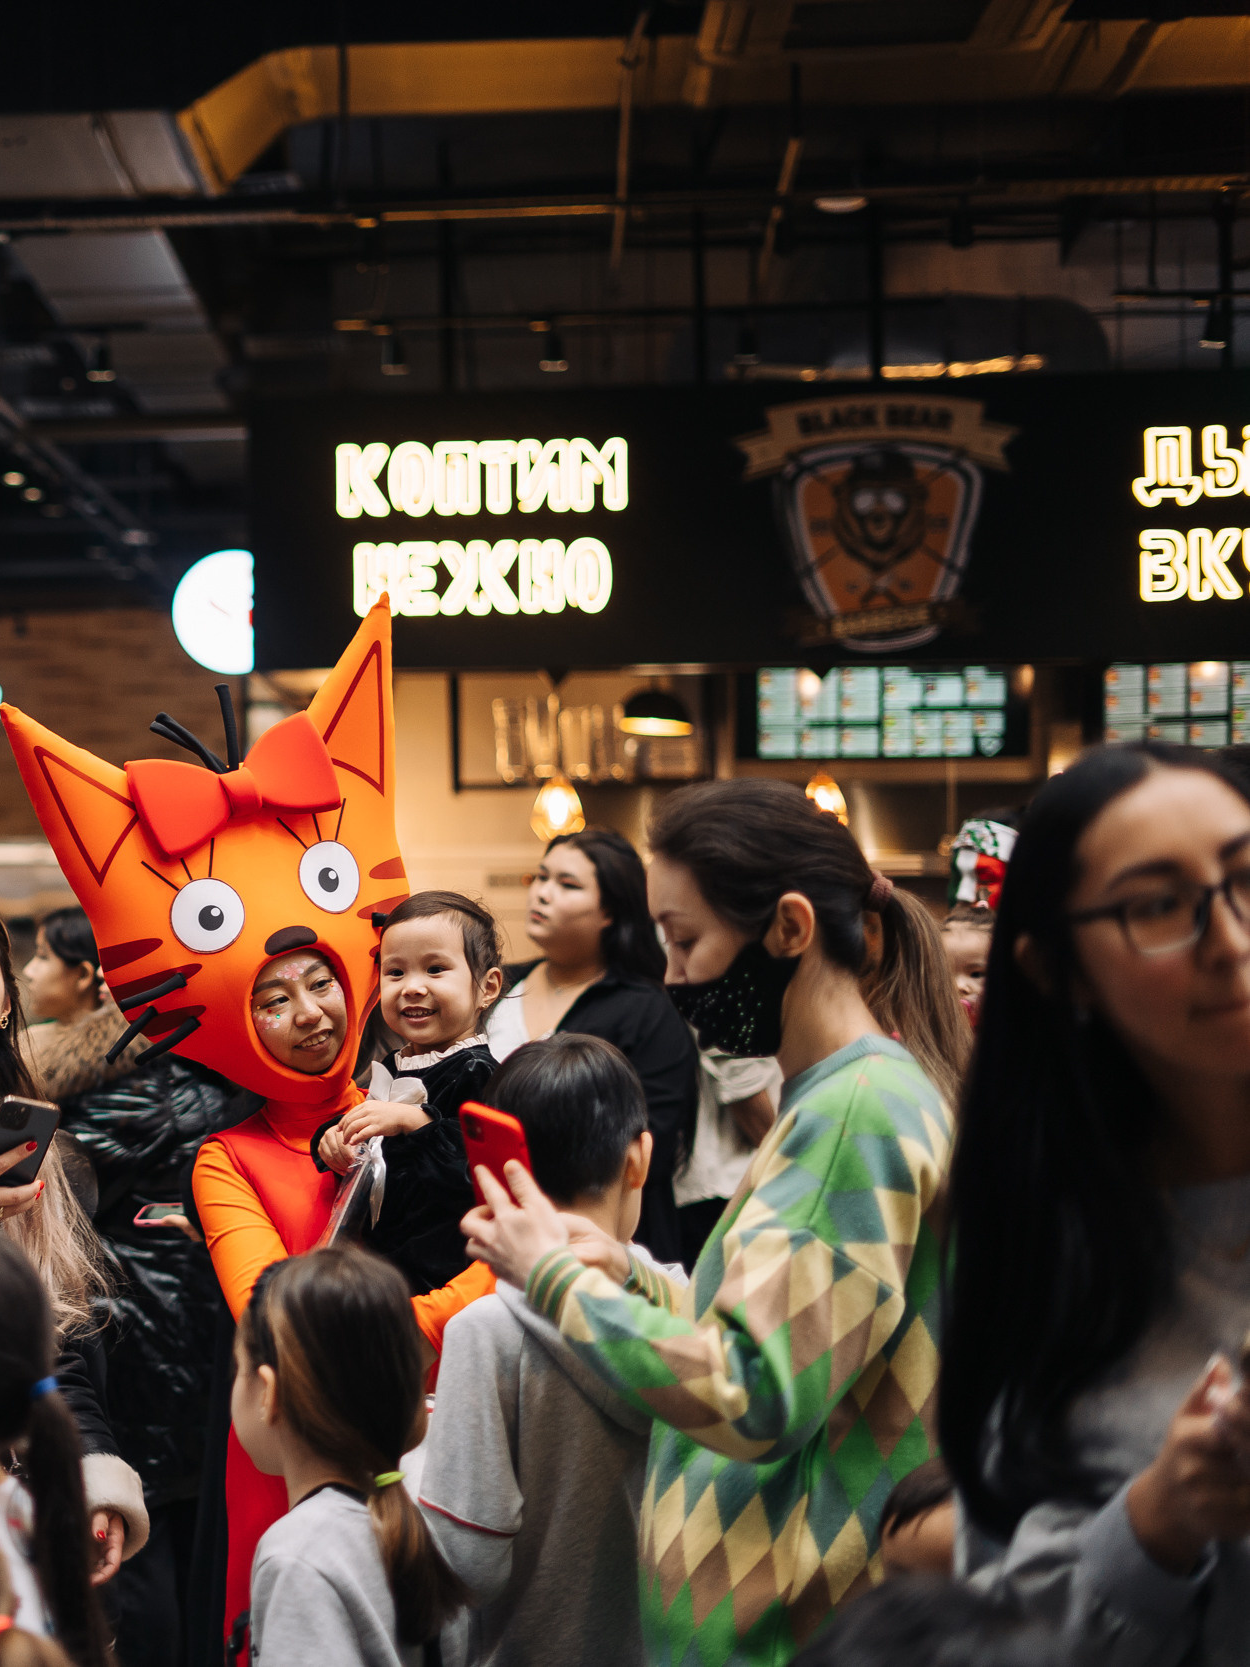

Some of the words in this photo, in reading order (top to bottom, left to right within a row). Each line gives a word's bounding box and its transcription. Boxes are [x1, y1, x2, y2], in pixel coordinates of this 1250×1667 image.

[797, 404, 877, 436] BLACK
[885, 402, 953, 430] BEAR
[335, 436, 629, 519] КОПТИМ
[352, 536, 614, 618] НЕЖНО
[1139, 526, 1250, 602] ВК
